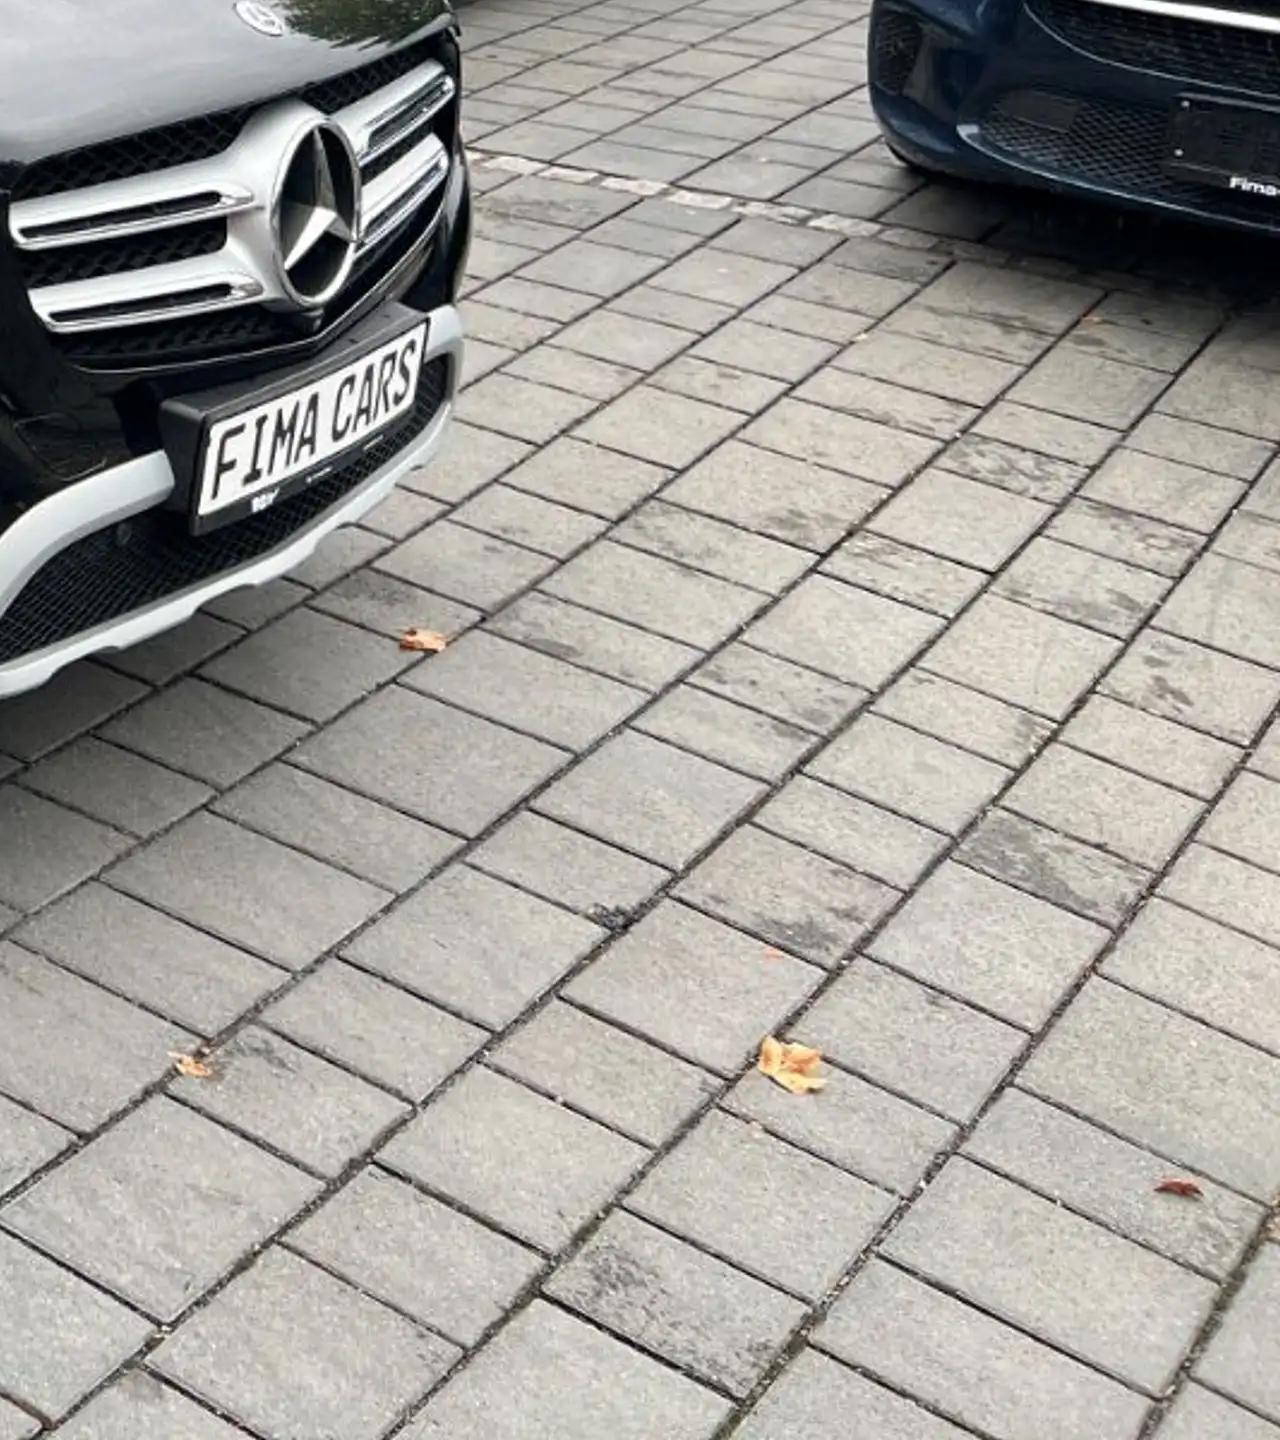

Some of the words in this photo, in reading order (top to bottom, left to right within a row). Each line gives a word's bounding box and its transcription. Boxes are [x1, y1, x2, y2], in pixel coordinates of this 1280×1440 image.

[1229, 176, 1280, 197] Fima
[211, 391, 320, 501] FIMA
[331, 338, 417, 444] CARS
